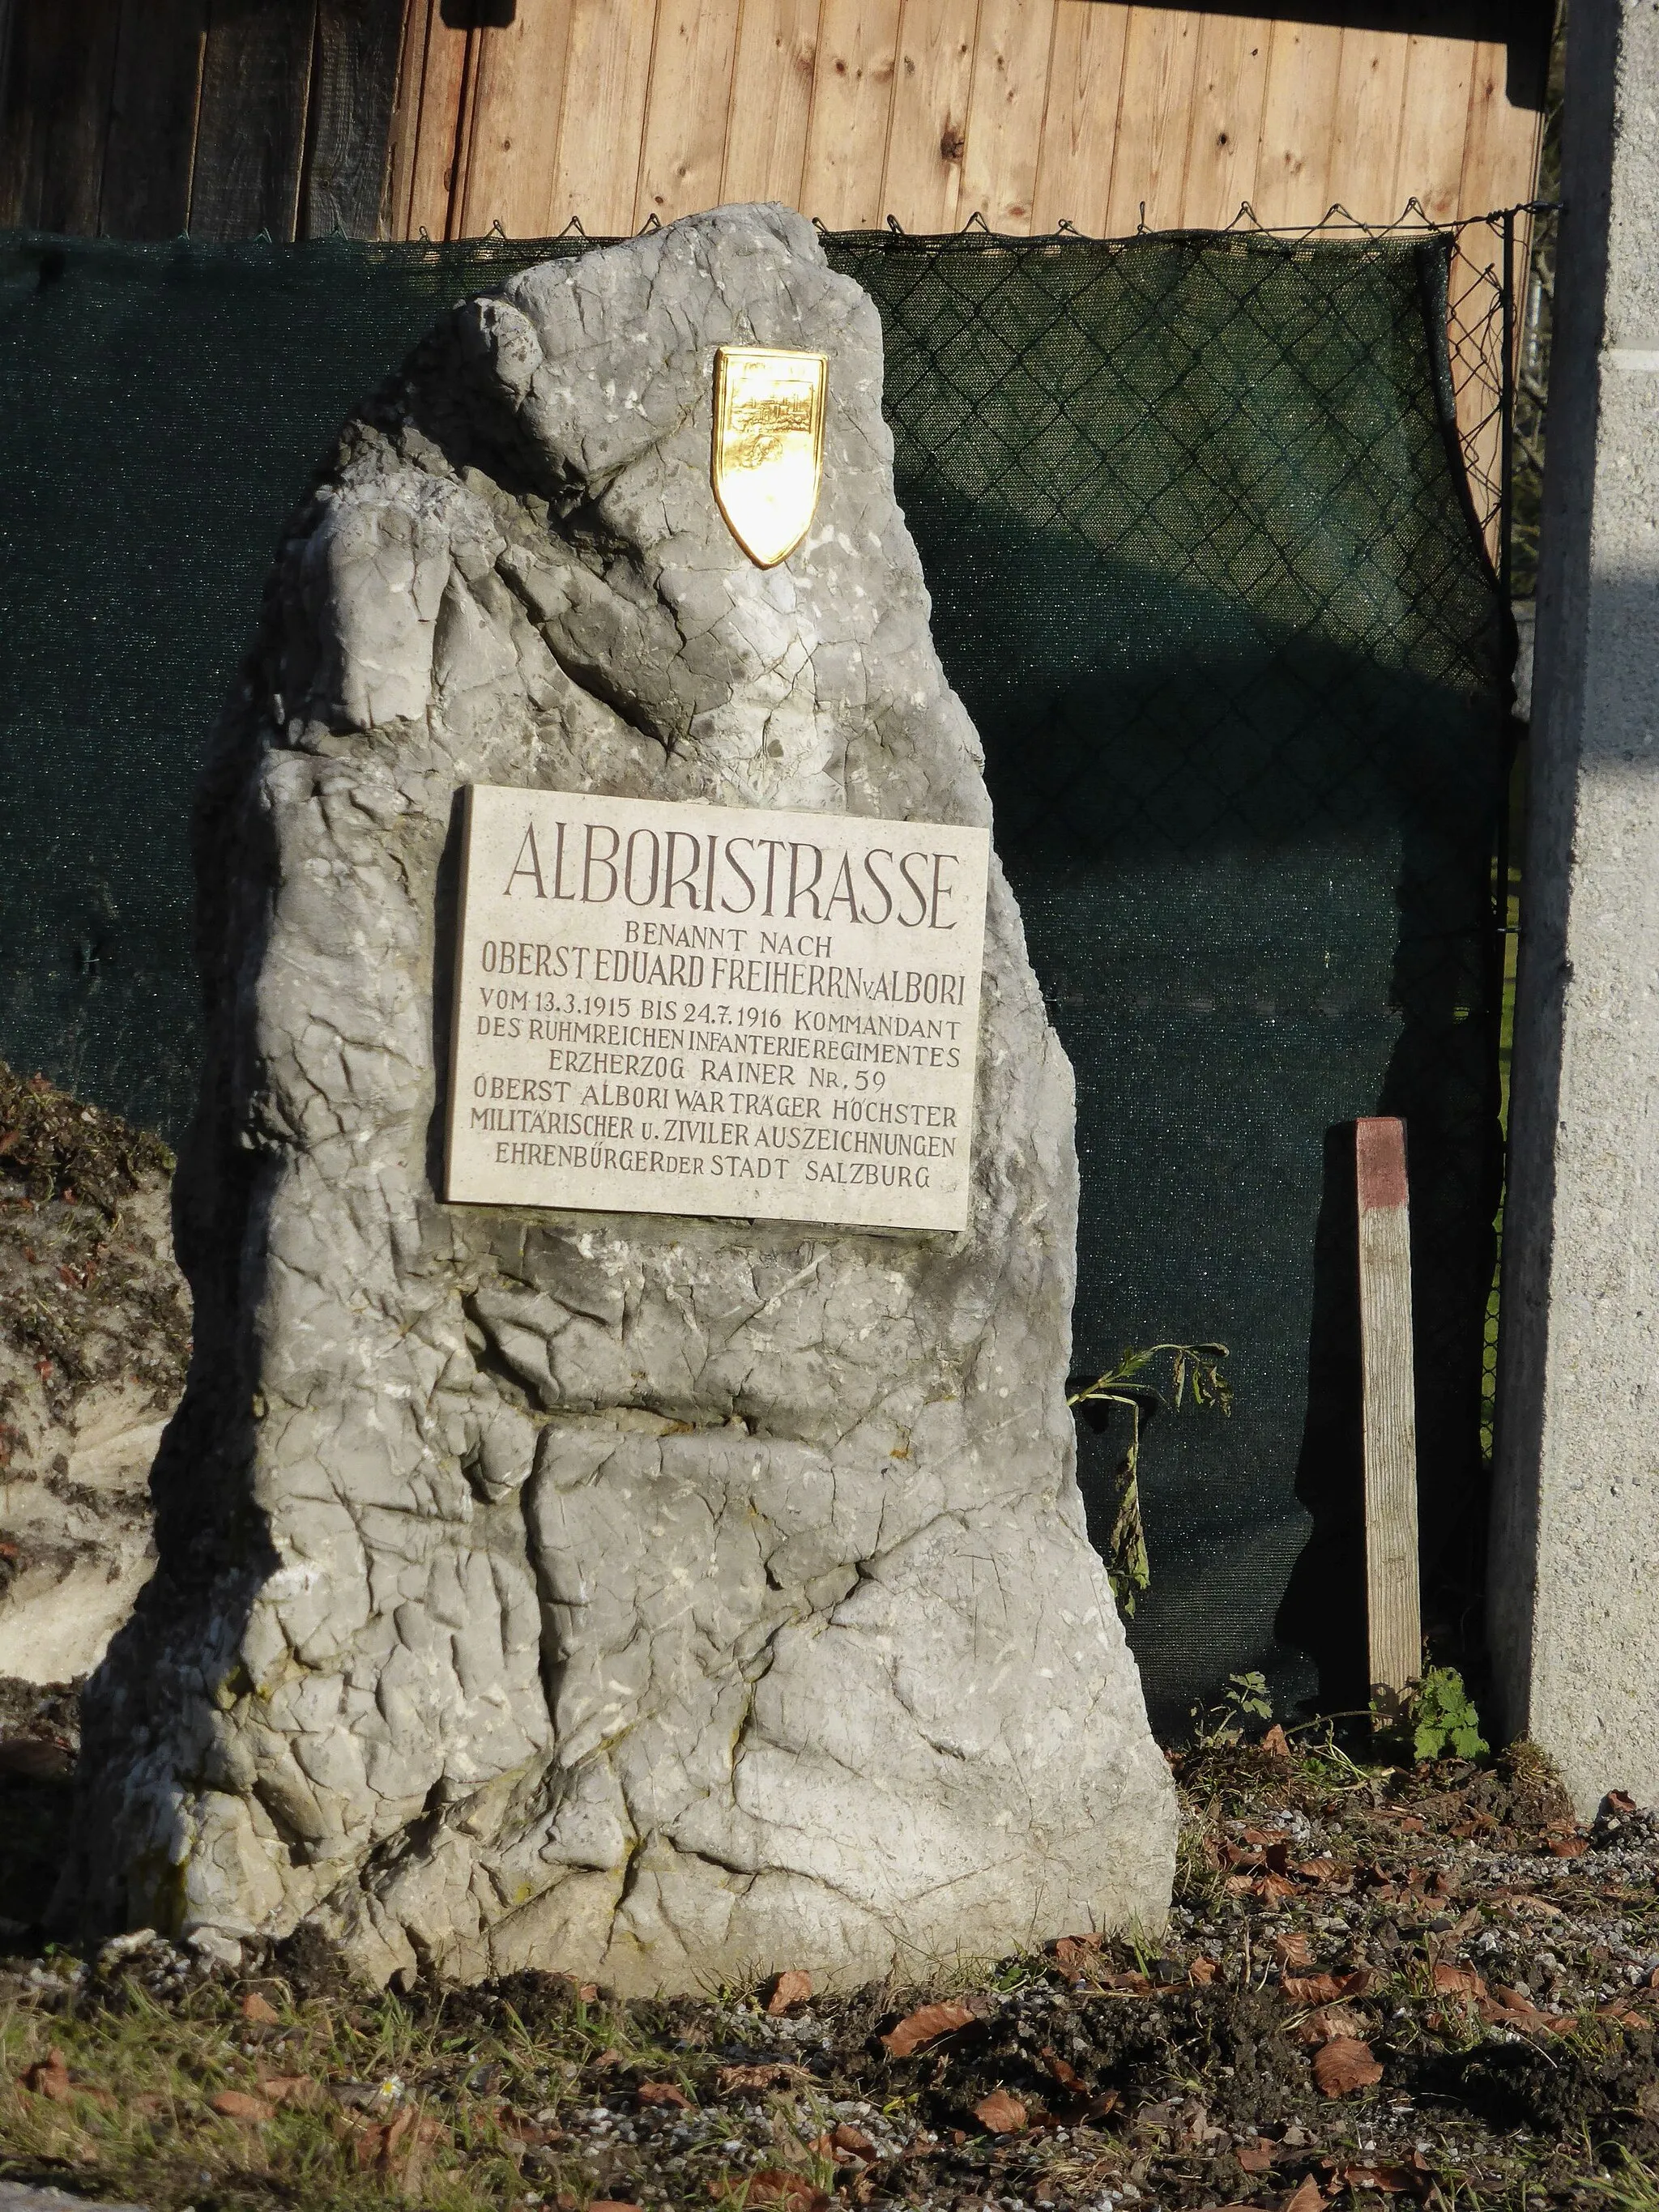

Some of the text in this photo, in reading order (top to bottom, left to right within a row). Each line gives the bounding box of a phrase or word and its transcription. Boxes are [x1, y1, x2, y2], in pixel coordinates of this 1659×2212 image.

[503, 821, 959, 929] ALBORISTRASSE
[625, 921, 832, 957] BENANNT NACH
[482, 940, 590, 979] OBERST
[595, 948, 704, 987] EDUARD
[711, 957, 863, 999] FREIHERRN
[478, 1016, 520, 1038] DES
[529, 1019, 684, 1050] RUHMREICHEN
[480, 987, 961, 1040] VOM 13.3.1915 BIS 24.7.1916 KOMMANDANT
[549, 1050, 684, 1077] ERZHERZOG
[702, 1059, 795, 1085] RAINER
[855, 1070, 885, 1093] 59
[474, 1076, 957, 1127] OBERST ALBORI WAR TRÄGER HÖCHSTER
[469, 1107, 634, 1139] MILITÄRISCHER
[664, 1119, 748, 1146] ZIVILER
[754, 1127, 956, 1157] AUSZEICHNUNGEN
[710, 1155, 790, 1179] STADT
[805, 1161, 930, 1188] SALZBURG
